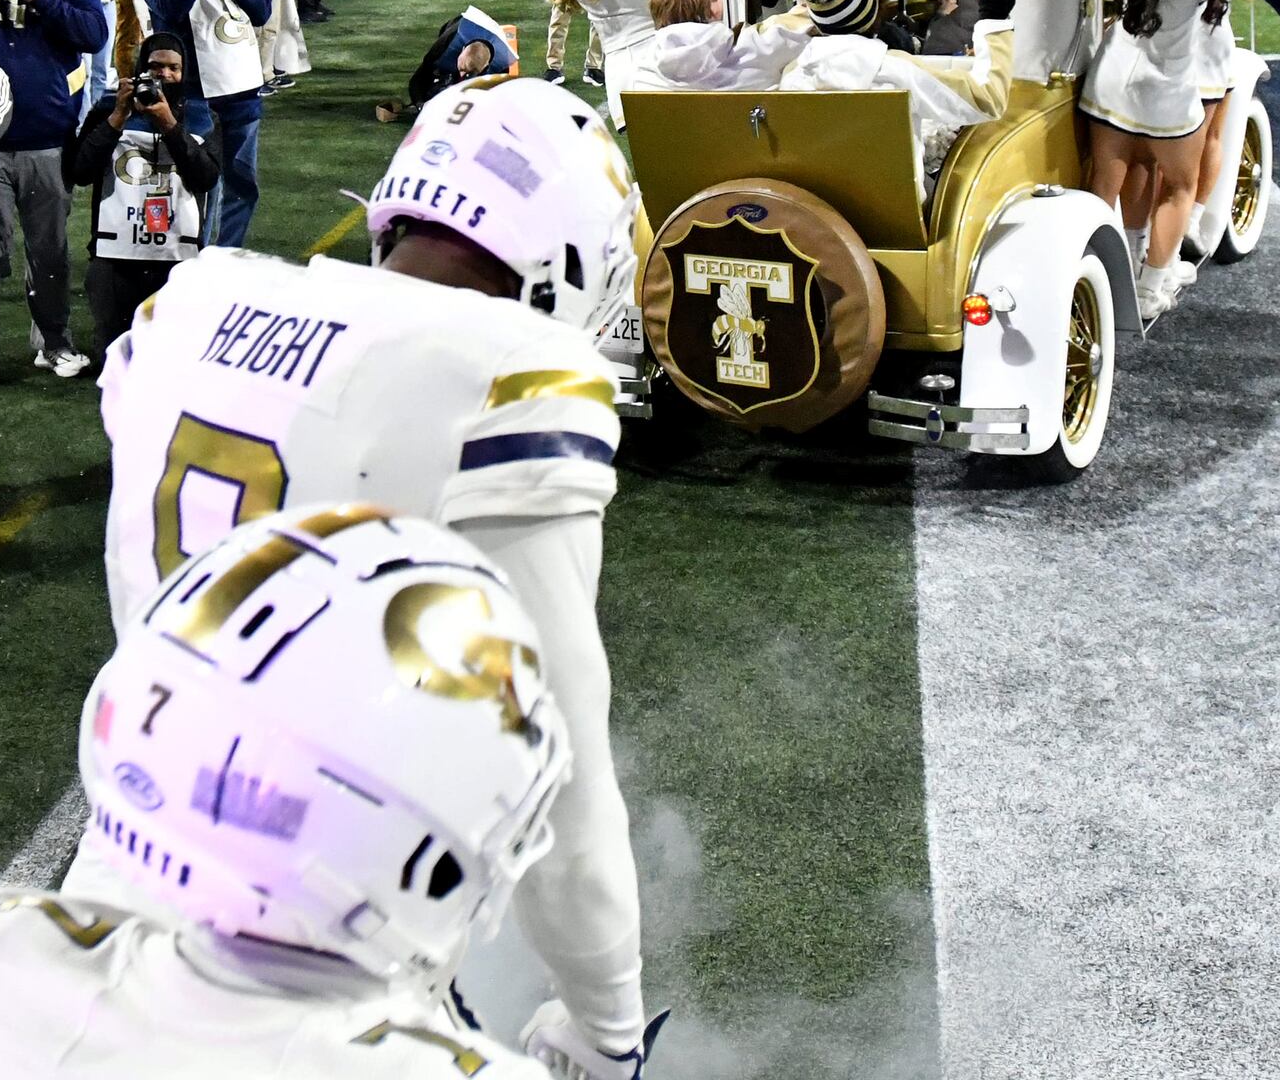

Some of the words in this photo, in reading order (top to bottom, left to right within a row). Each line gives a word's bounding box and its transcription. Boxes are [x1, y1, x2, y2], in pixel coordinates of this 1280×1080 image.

[447, 101, 474, 125] 9
[692, 259, 783, 283] GEORGIA
[199, 302, 348, 387] HEIGHT
[721, 362, 765, 382] TECH
[141, 683, 176, 736] 7
